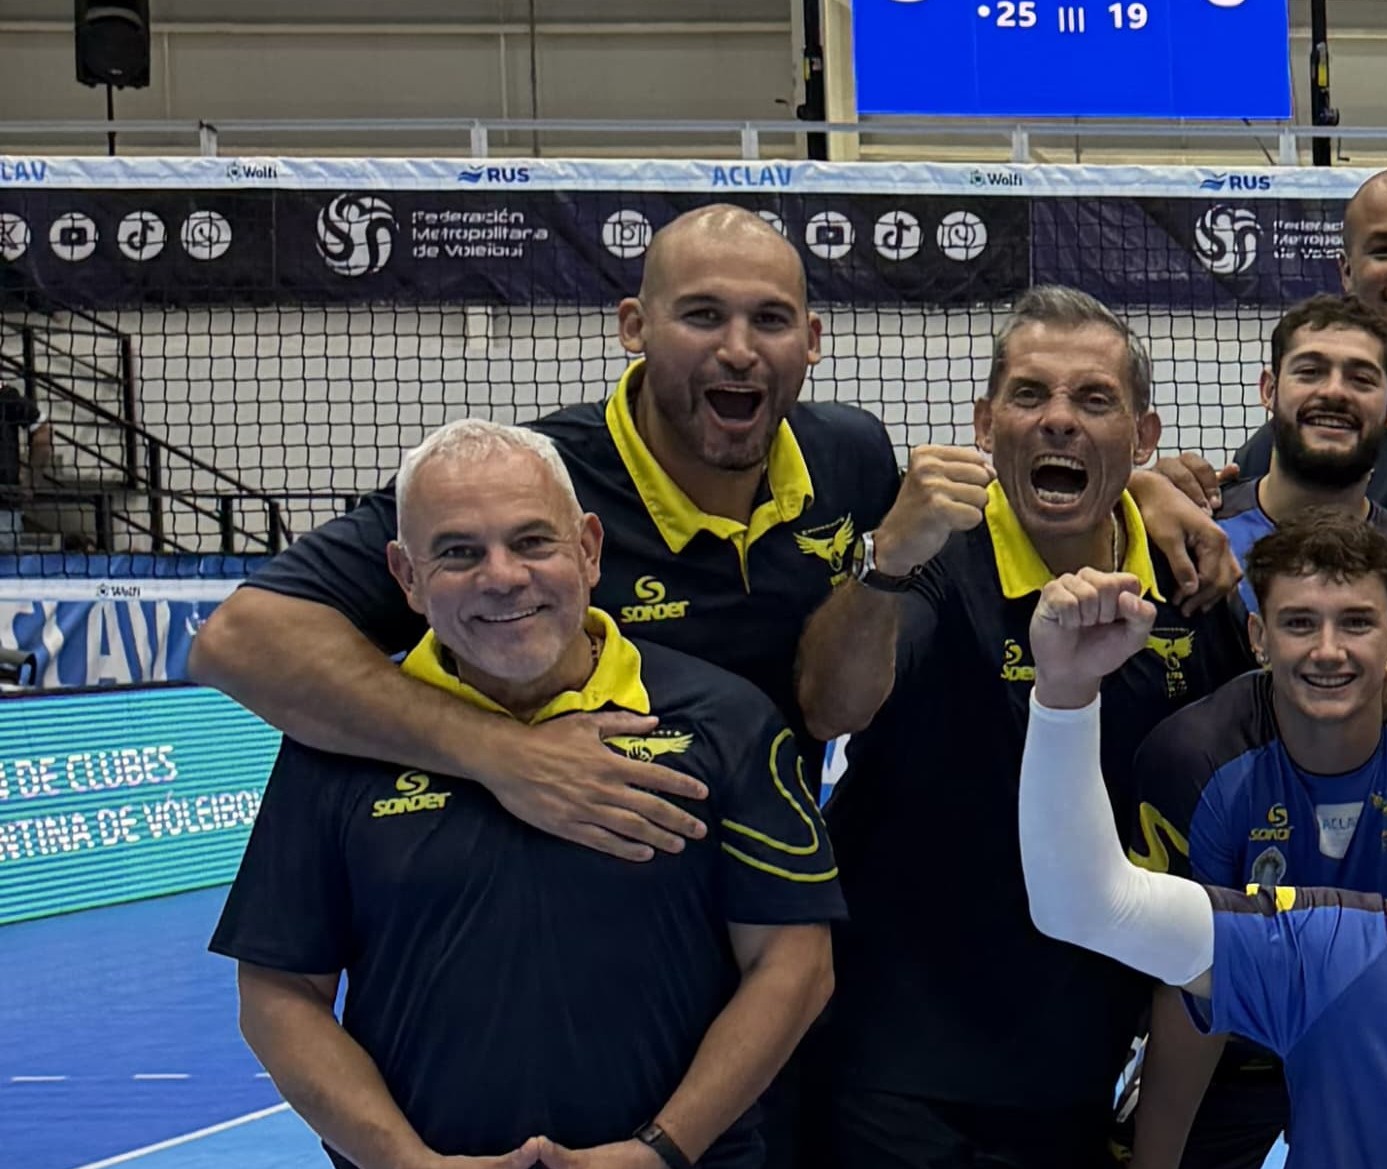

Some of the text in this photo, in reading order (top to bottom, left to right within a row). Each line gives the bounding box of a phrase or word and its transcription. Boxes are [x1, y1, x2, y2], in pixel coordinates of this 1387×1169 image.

[996, 1, 1037, 28] 25
[1108, 2, 1148, 30] 19
[487, 166, 531, 183] RUS
[711, 164, 793, 188] ACLAV
[987, 171, 1024, 187] Wolfi
[1229, 174, 1272, 191] RUS
[15, 756, 61, 798] DE
[66, 744, 178, 794] CLUBES
[97, 804, 141, 846] DE
